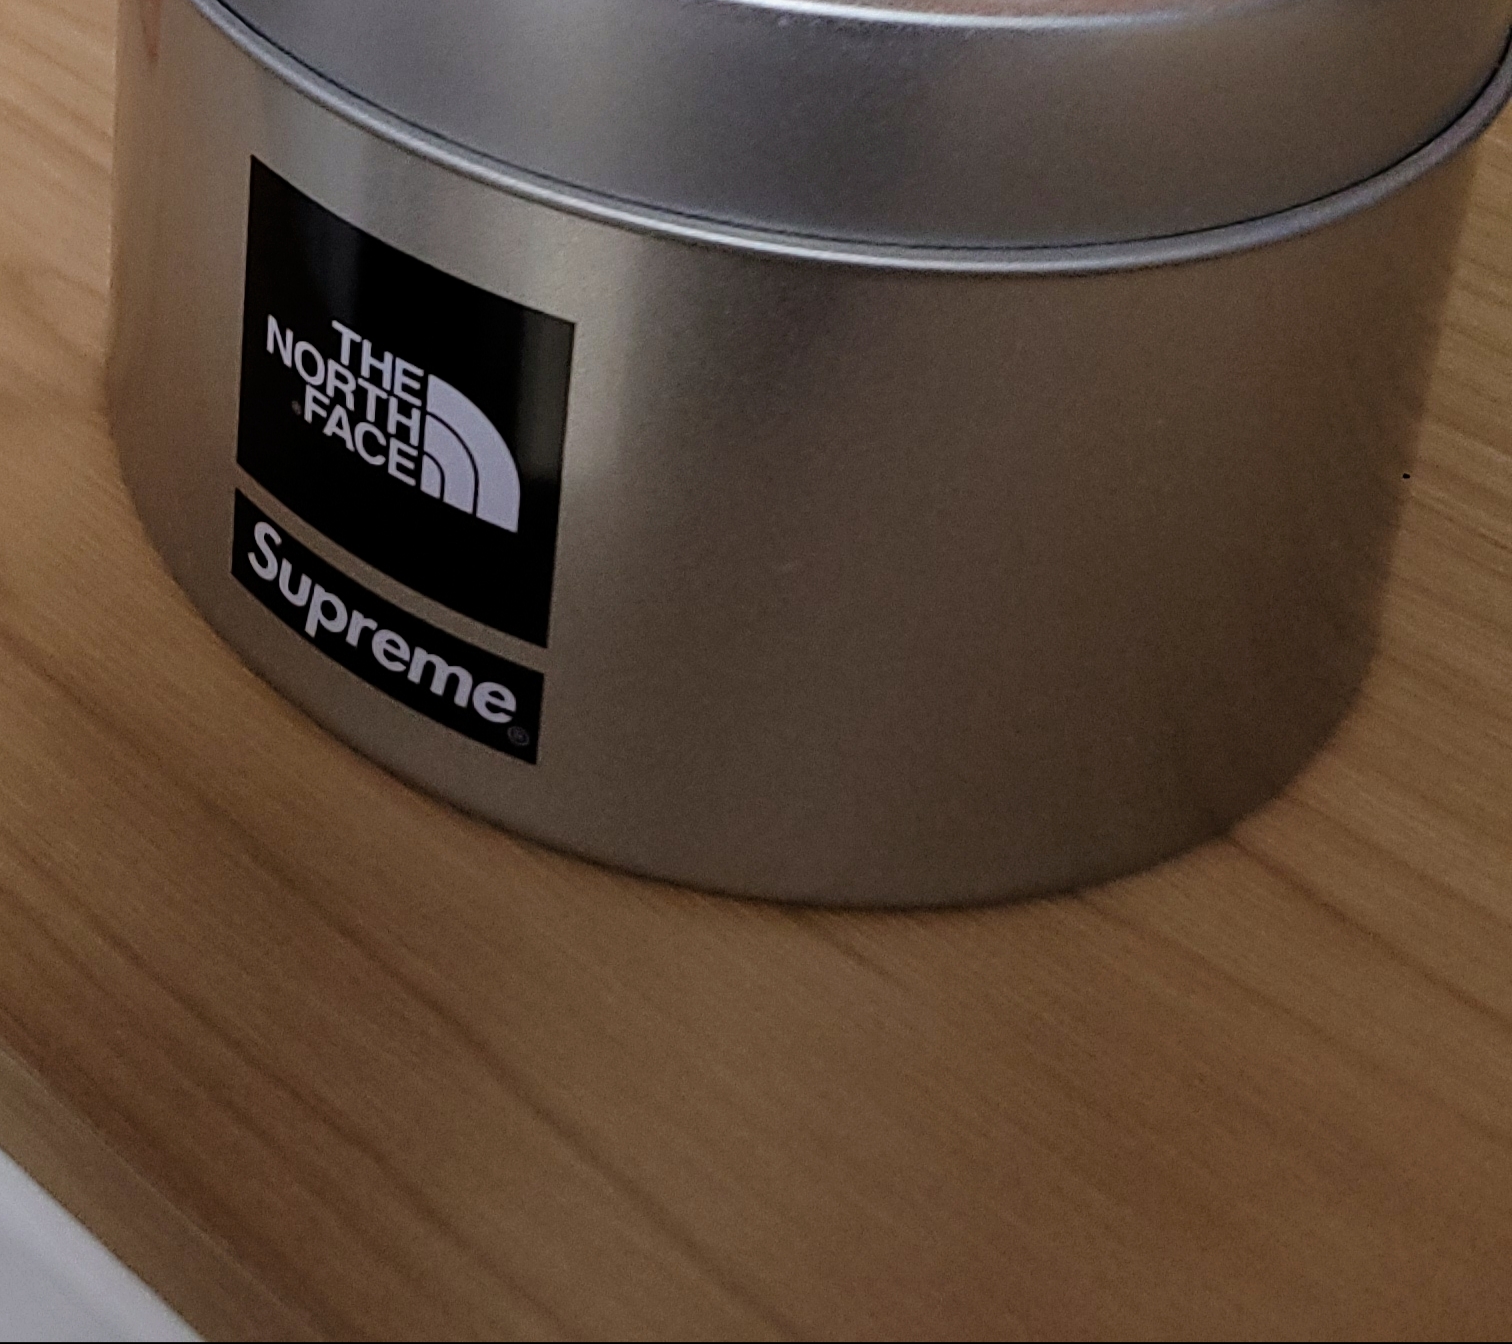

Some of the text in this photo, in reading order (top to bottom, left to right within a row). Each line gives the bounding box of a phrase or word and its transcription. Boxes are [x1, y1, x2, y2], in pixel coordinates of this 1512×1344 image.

[266, 313, 421, 447] NORTH
[331, 319, 425, 407] THE
[304, 383, 419, 487] FACE
[247, 520, 516, 724] Supreme
